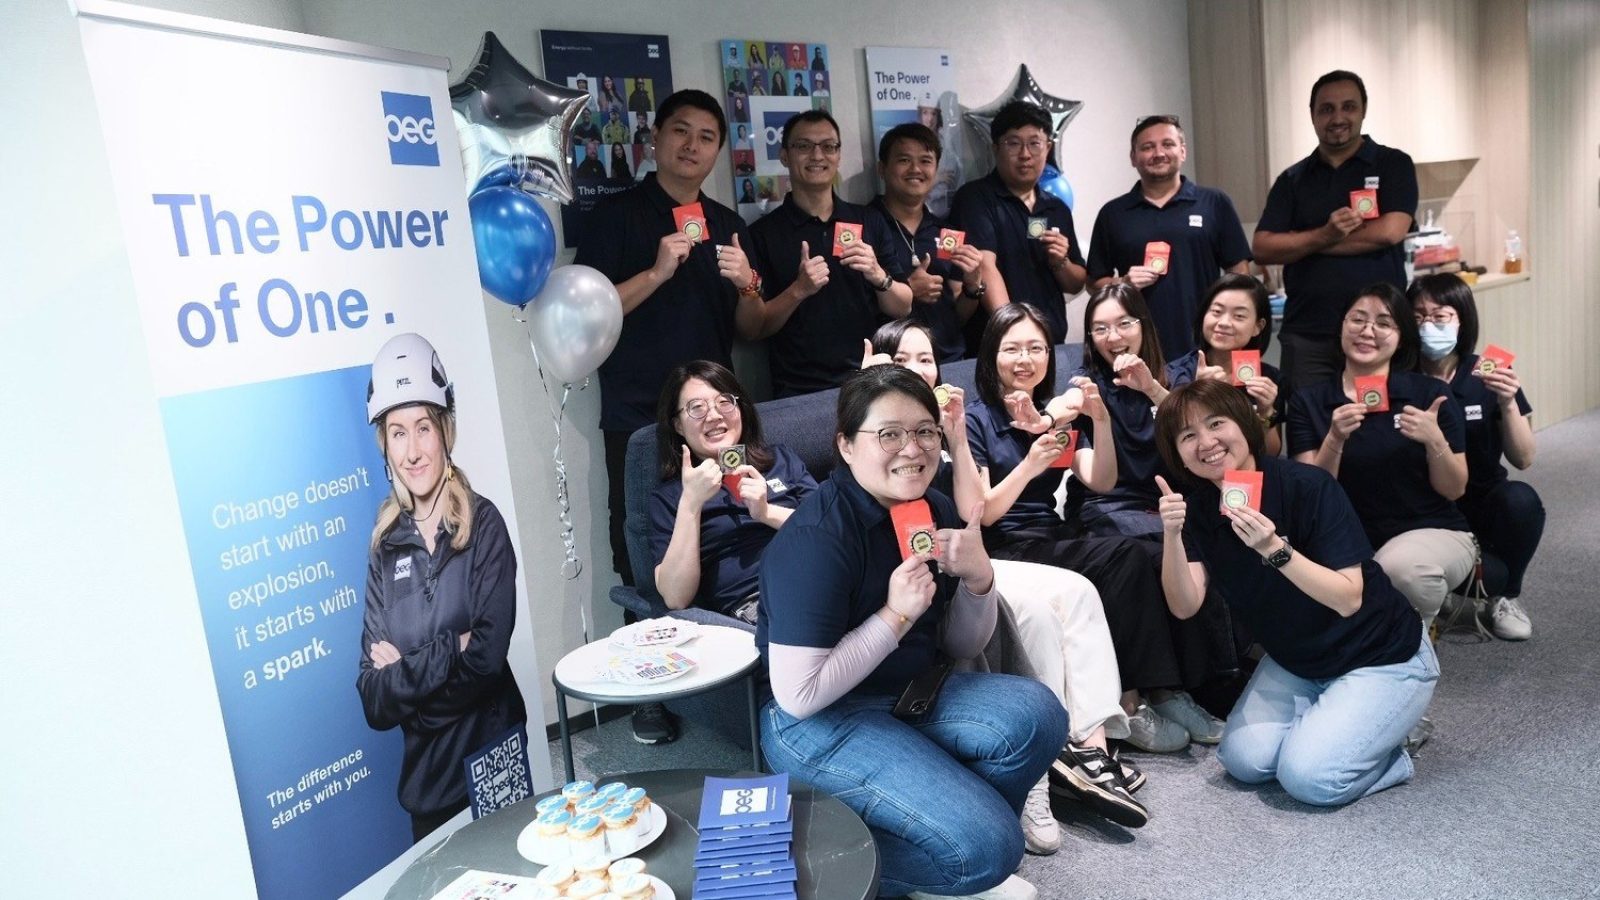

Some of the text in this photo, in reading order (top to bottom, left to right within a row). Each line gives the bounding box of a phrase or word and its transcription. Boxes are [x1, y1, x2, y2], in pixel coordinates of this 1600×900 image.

[875, 72, 930, 84] The Power
[877, 88, 887, 100] of
[578, 186, 595, 195] The
[152, 193, 448, 257] The Power
[177, 282, 240, 348] of
[212, 491, 299, 529] Change
[220, 516, 346, 570] start with an
[228, 560, 335, 610] explosion,
[235, 585, 357, 650] it starts with
[244, 637, 331, 689] a spark.
[267, 749, 363, 808] The difference
[271, 766, 371, 829] starts with you.
